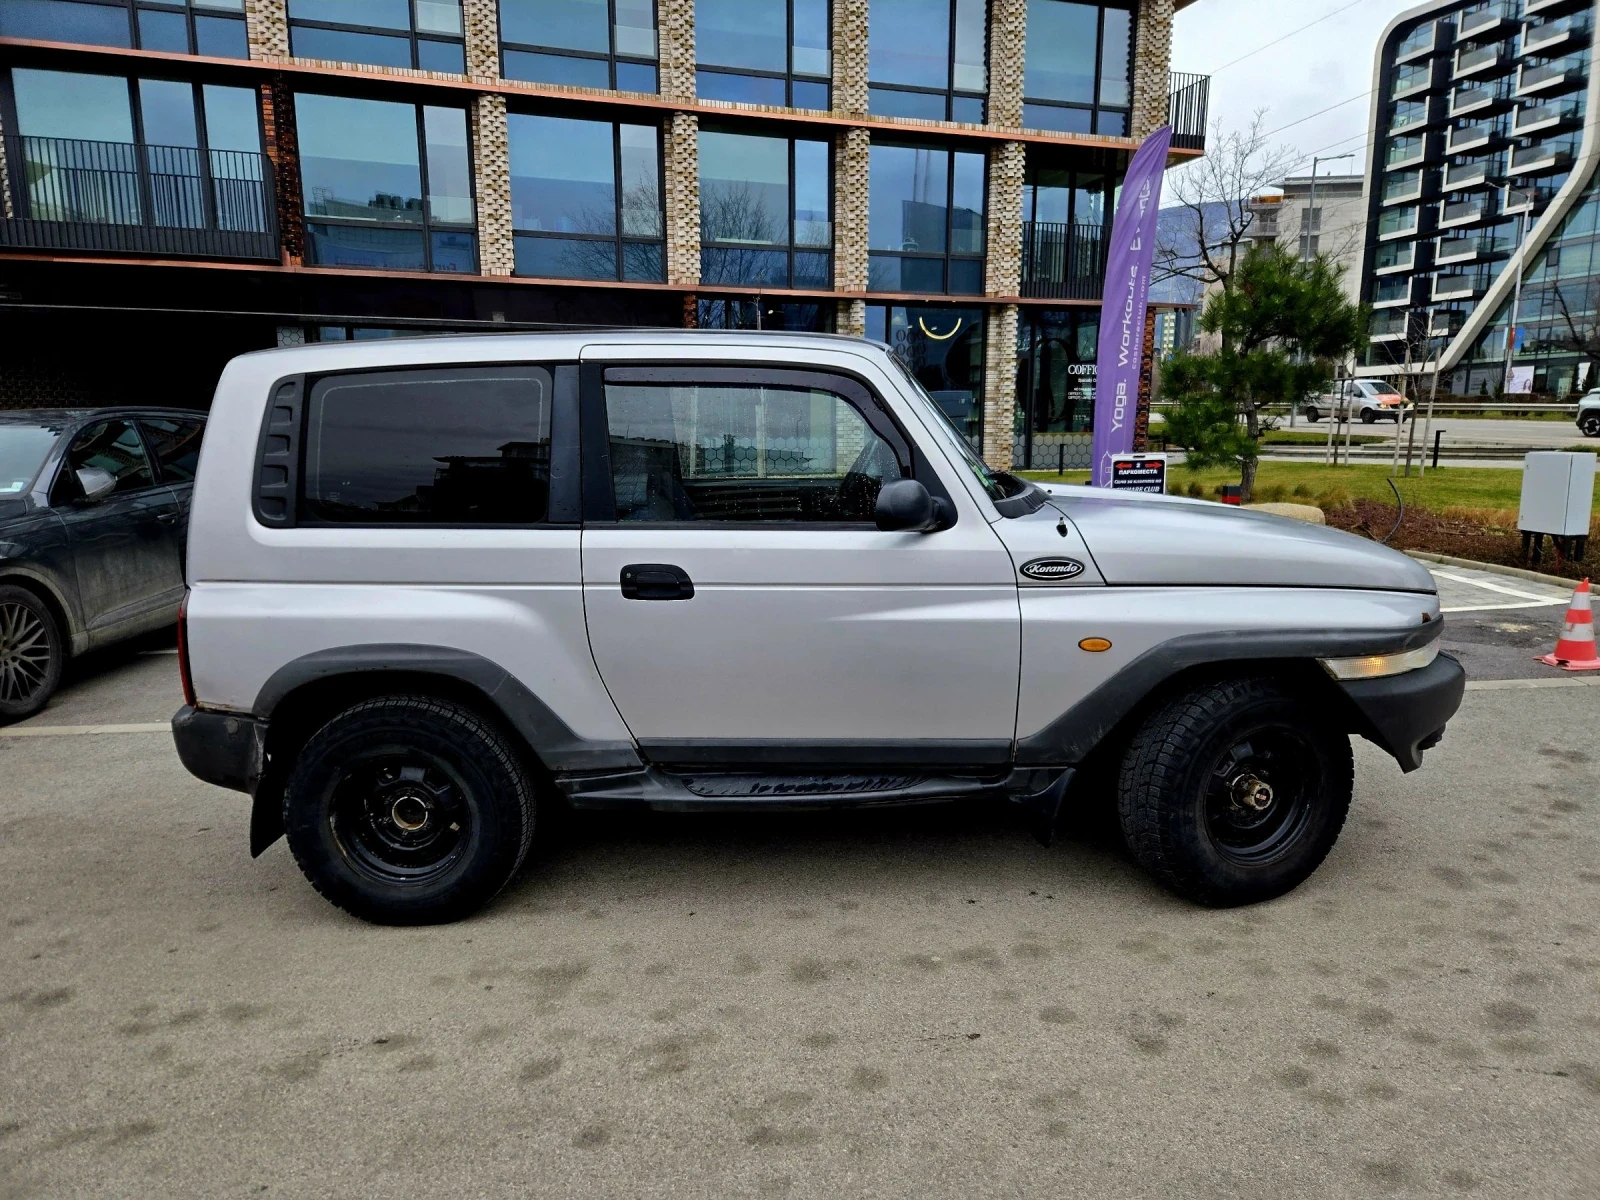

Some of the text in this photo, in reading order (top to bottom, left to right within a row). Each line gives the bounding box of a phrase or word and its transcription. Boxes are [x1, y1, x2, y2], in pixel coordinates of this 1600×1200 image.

[1118, 261, 1140, 367] Workouts.
[1131, 275, 1147, 370] coshareclub.com
[1111, 378, 1127, 433] Yoga.
[1029, 563, 1078, 573] Korando
